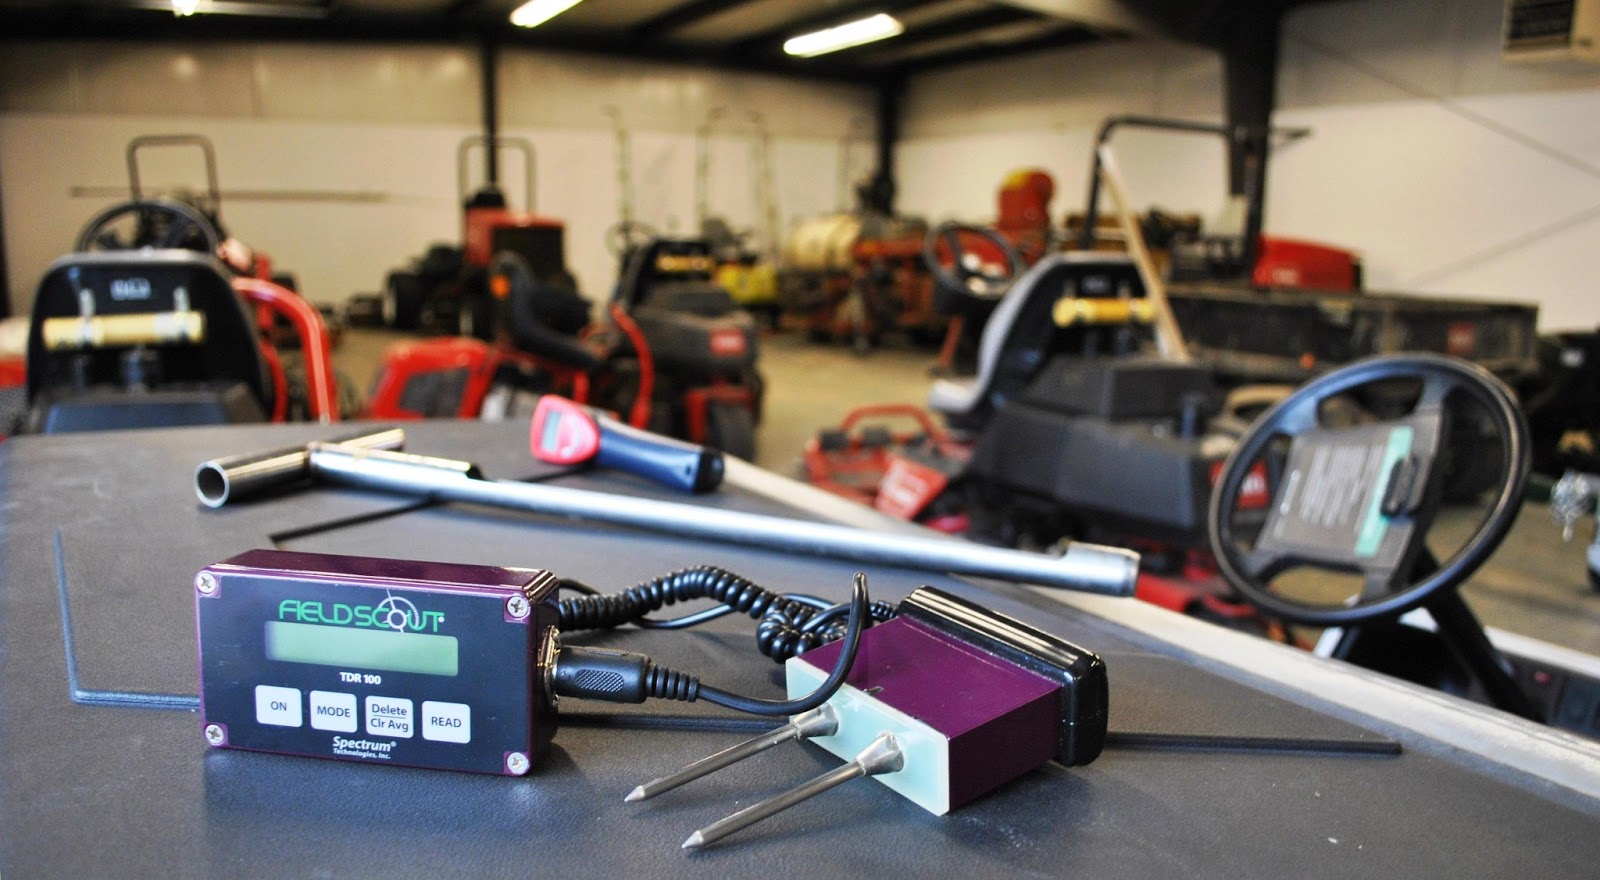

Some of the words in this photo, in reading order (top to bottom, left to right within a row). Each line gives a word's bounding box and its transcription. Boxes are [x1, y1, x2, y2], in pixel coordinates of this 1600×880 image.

[279, 599, 445, 632] FIELDSCOUT
[339, 671, 362, 683] TDR
[363, 674, 382, 685] 100
[270, 701, 288, 712] ON
[317, 704, 351, 718] MODE
[371, 703, 408, 716] Delete
[370, 718, 386, 728] Clr
[388, 719, 409, 733] Avg
[431, 716, 462, 728] READ
